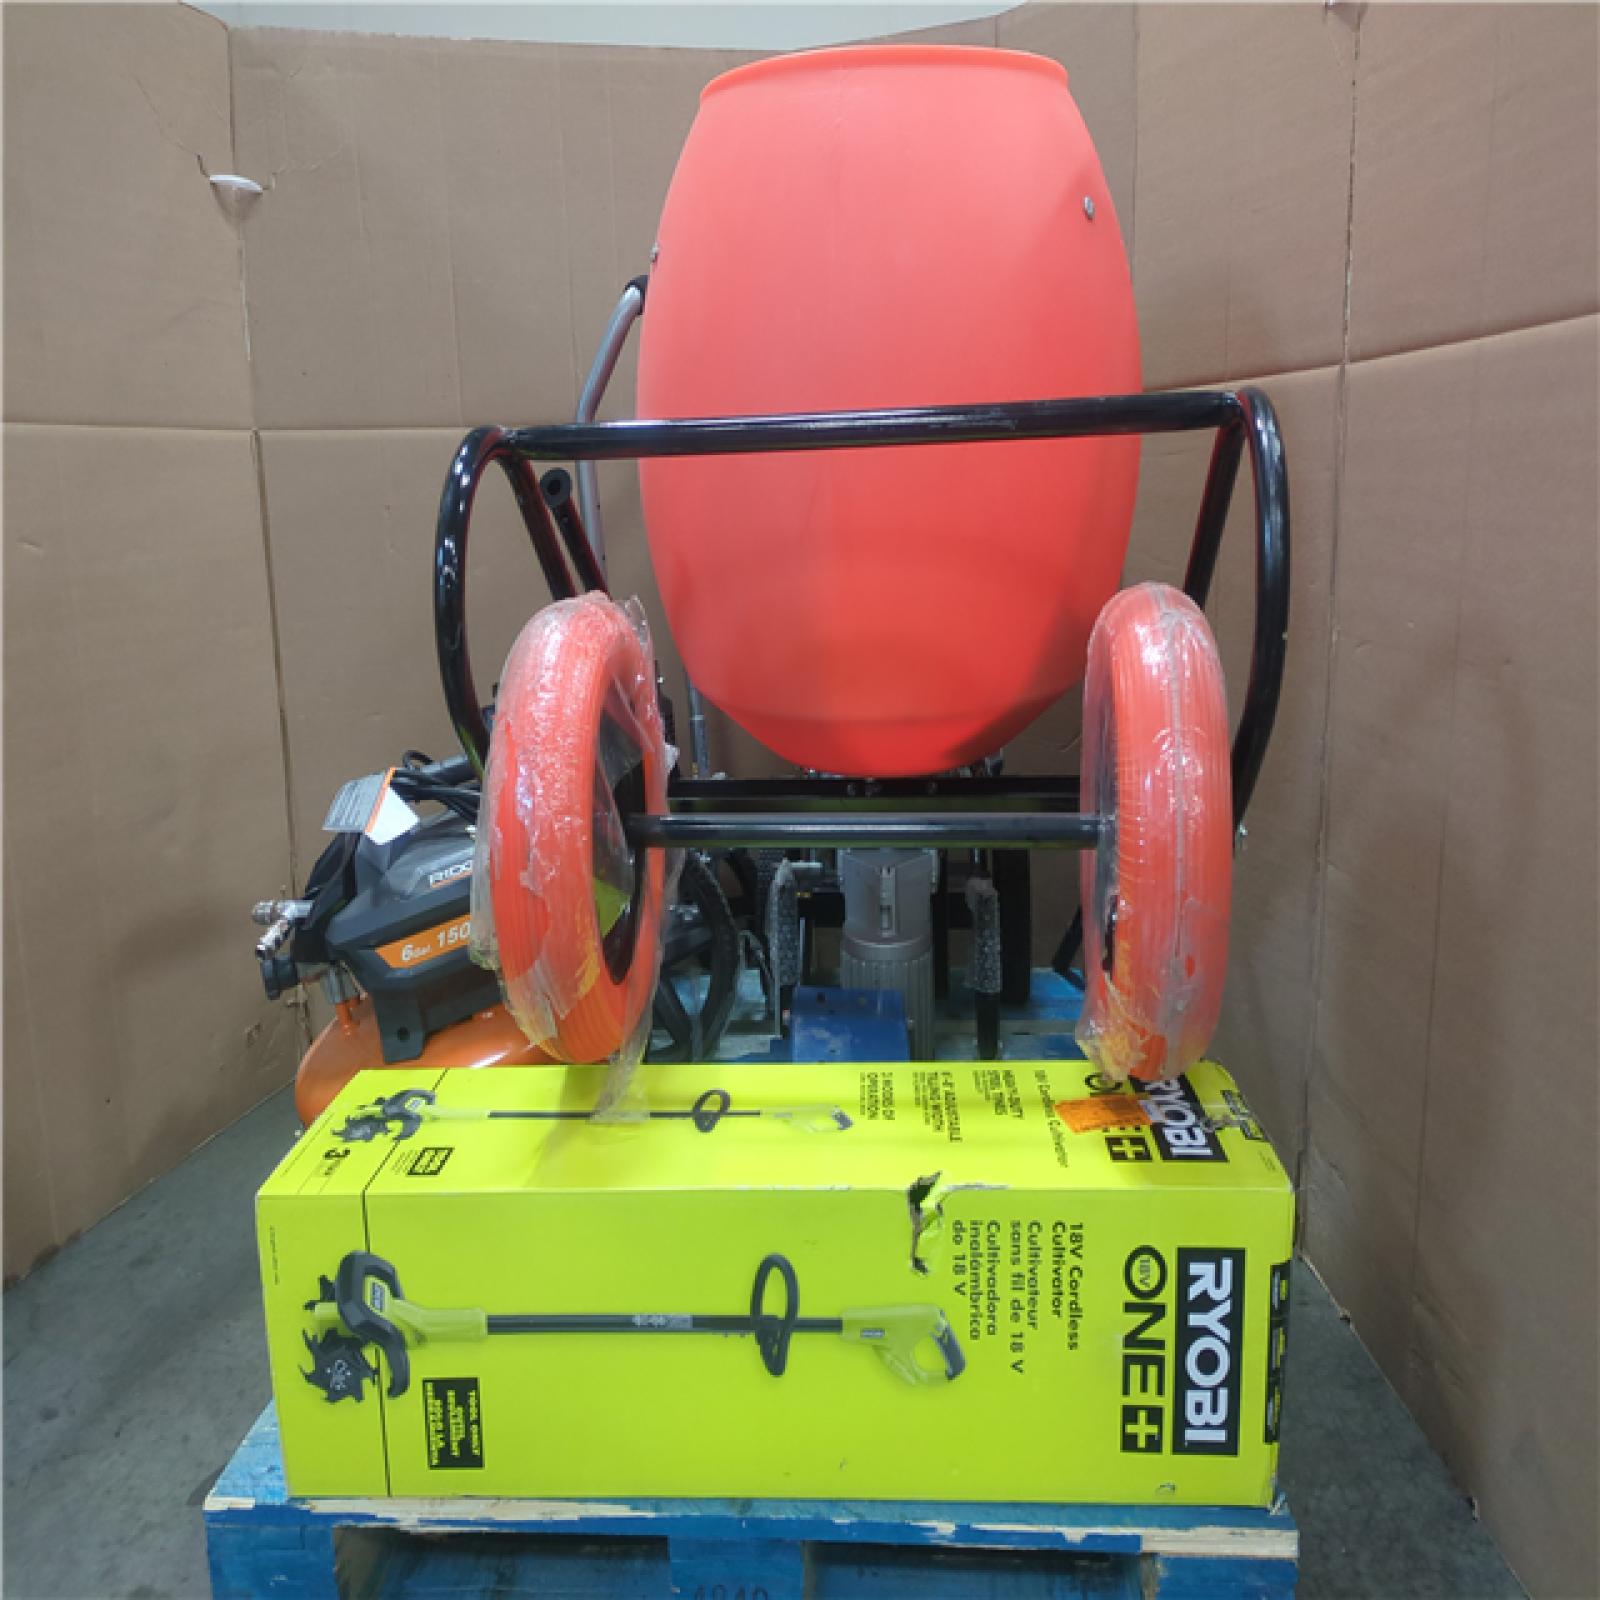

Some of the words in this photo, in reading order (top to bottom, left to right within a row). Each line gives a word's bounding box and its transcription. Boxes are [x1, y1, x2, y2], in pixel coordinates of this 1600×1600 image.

[1010, 1221, 1022, 1265] sans
[1069, 1222, 1083, 1259] 18V
[953, 1252, 966, 1275] 18
[986, 1221, 999, 1336] Cultivadora
[1011, 1272, 1024, 1291] fil
[1027, 1221, 1042, 1329] Cultivateur
[1051, 1221, 1065, 1318] Cultivator
[954, 1282, 966, 1296] V
[1011, 1298, 1024, 1322] de
[1067, 1266, 1083, 1350] Cordless
[1010, 1331, 1023, 1353] 18
[1184, 1257, 1233, 1447] RYOBI
[1010, 1359, 1023, 1374] V
